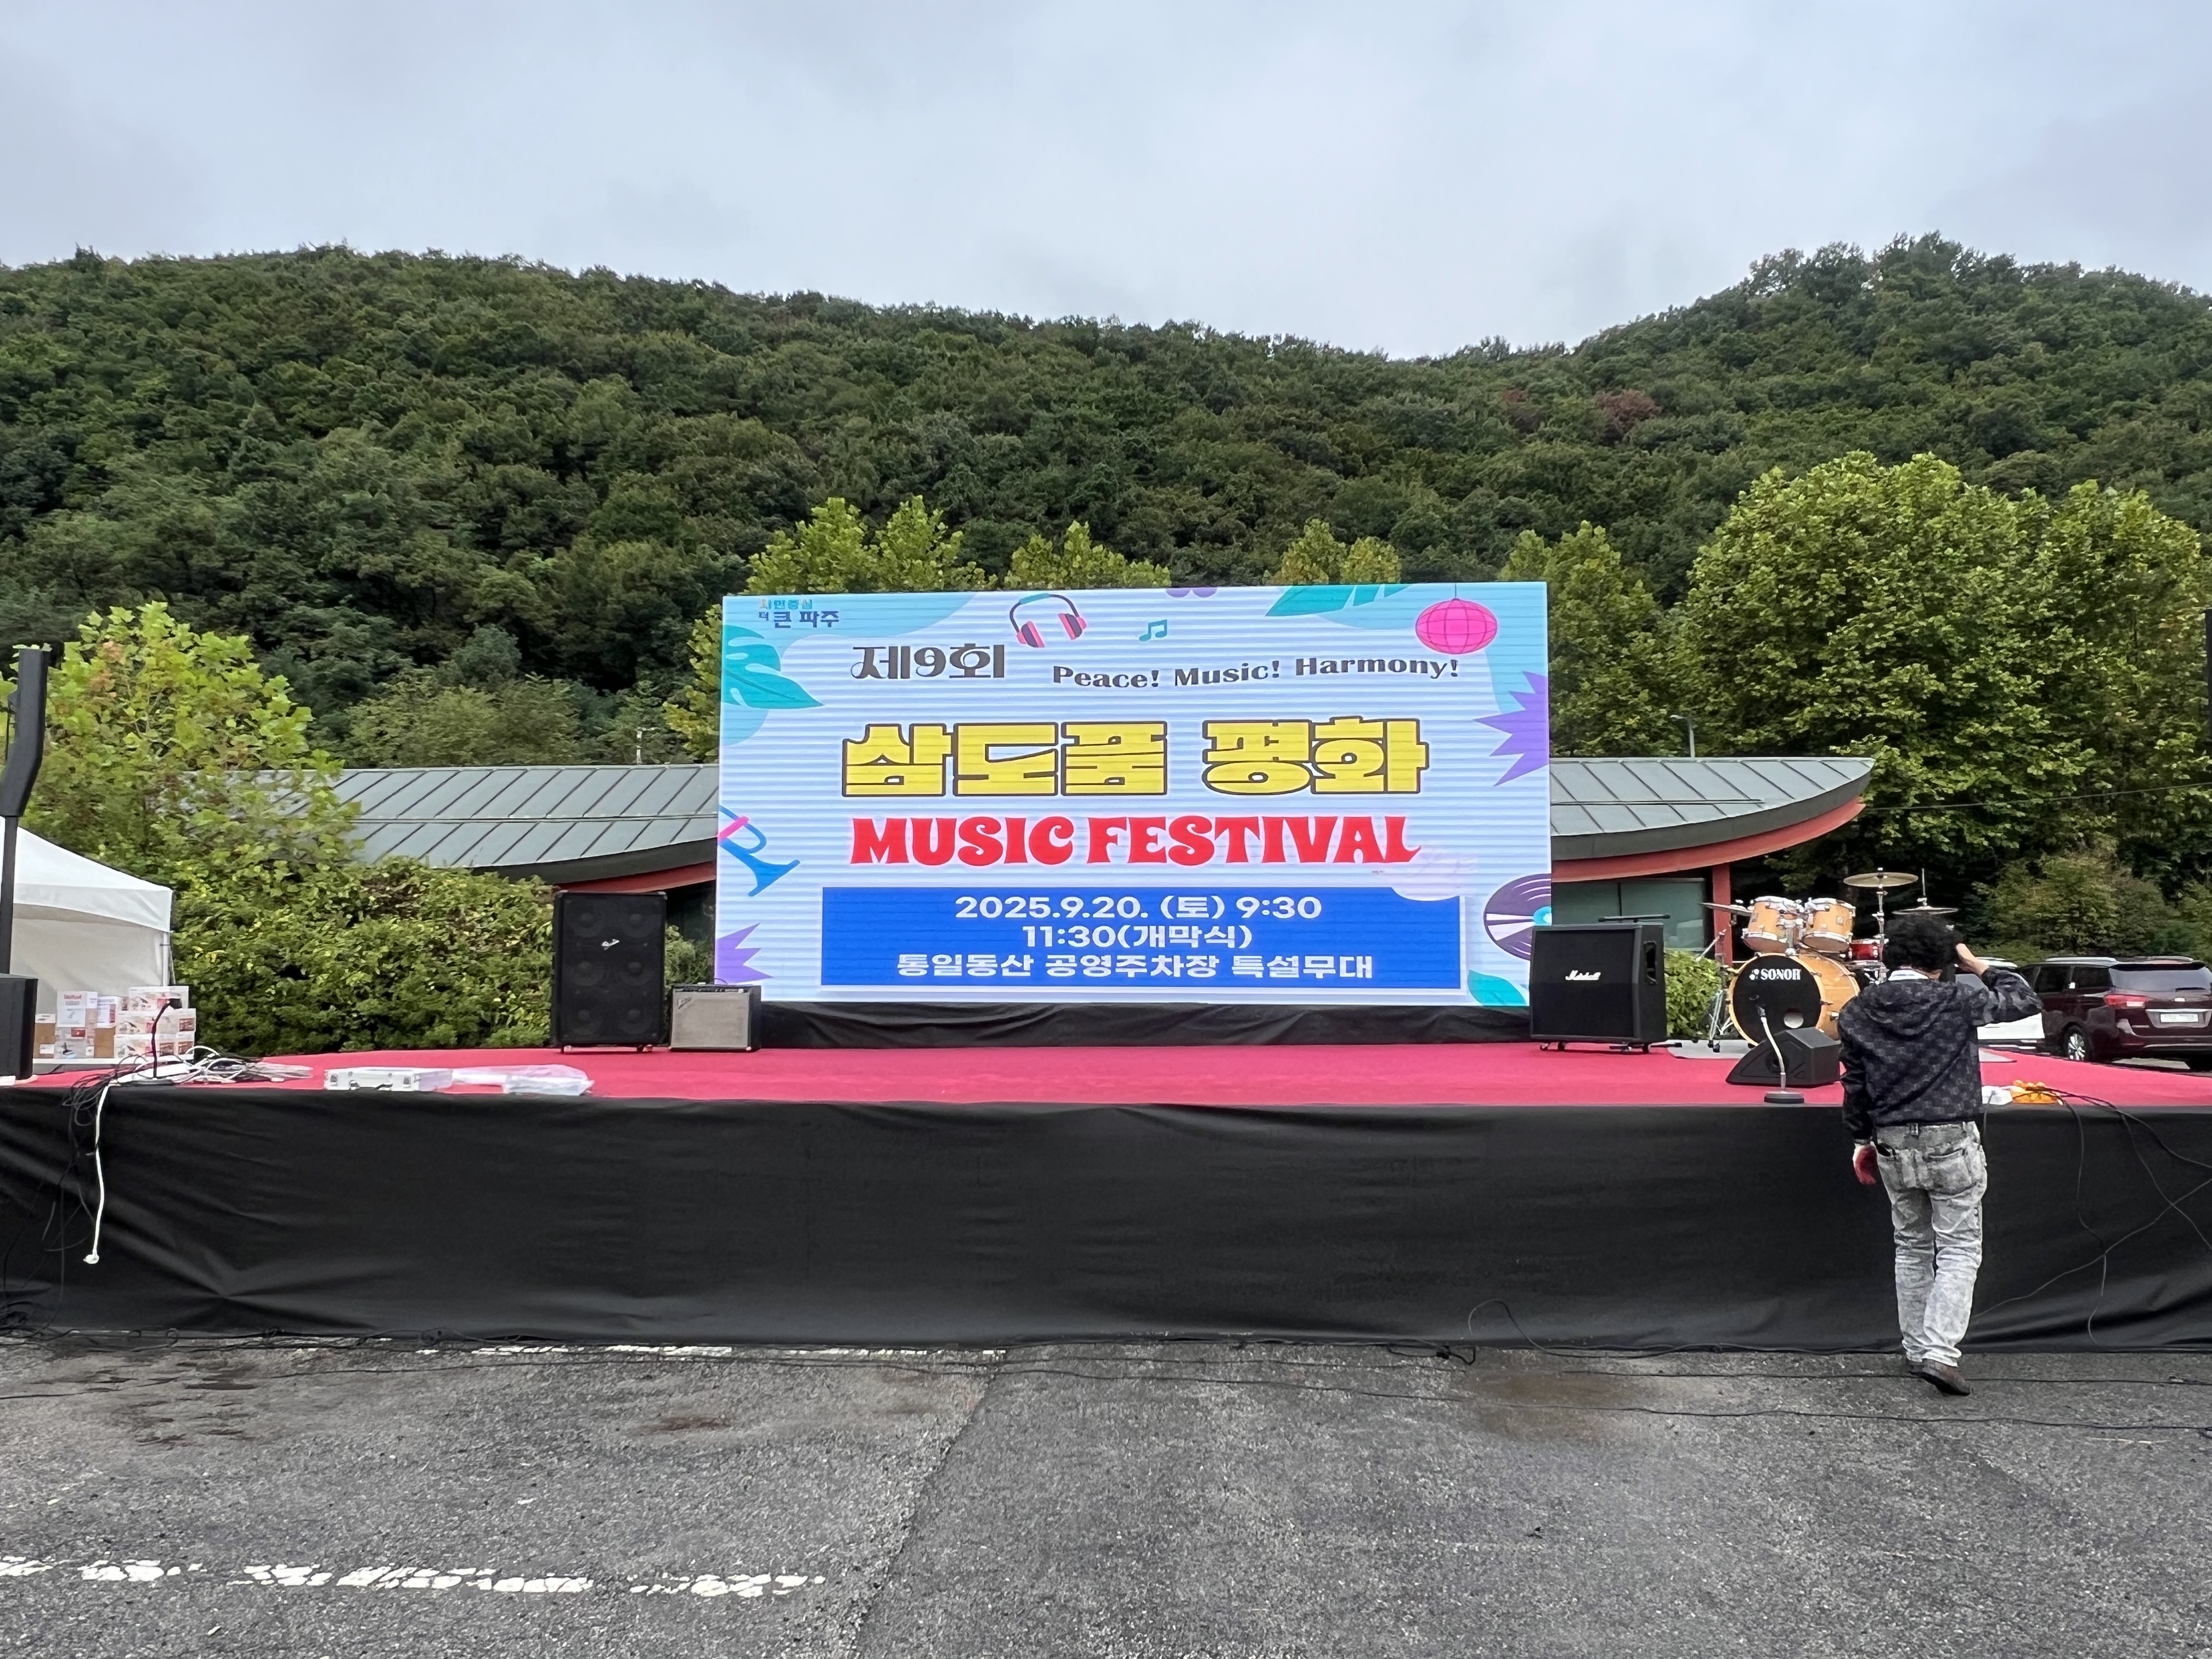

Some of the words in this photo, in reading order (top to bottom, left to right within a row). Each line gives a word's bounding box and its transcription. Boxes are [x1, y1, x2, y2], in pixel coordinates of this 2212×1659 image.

[774, 611, 792, 628] 큰
[799, 611, 839, 628] 파주
[851, 643, 1005, 679] 제9회
[1053, 665, 1159, 688] Peace!
[1175, 661, 1279, 686] Music!
[1295, 658, 1458, 679] Harmony!
[842, 721, 1167, 797] 삼도품
[1202, 716, 1429, 795] 평화
[850, 816, 1074, 866] MUSIC
[1088, 815, 1421, 865] FESTIVAL
[955, 896, 1148, 918] 2025.9.20.
[1160, 895, 1225, 919] (토)
[1236, 896, 1322, 919] 9:30
[1022, 925, 1252, 949] 11:30(개막식)
[897, 954, 1035, 977] 통일동산
[1045, 955, 1220, 978] 공영주차장
[1232, 955, 1373, 979] 특설무대
